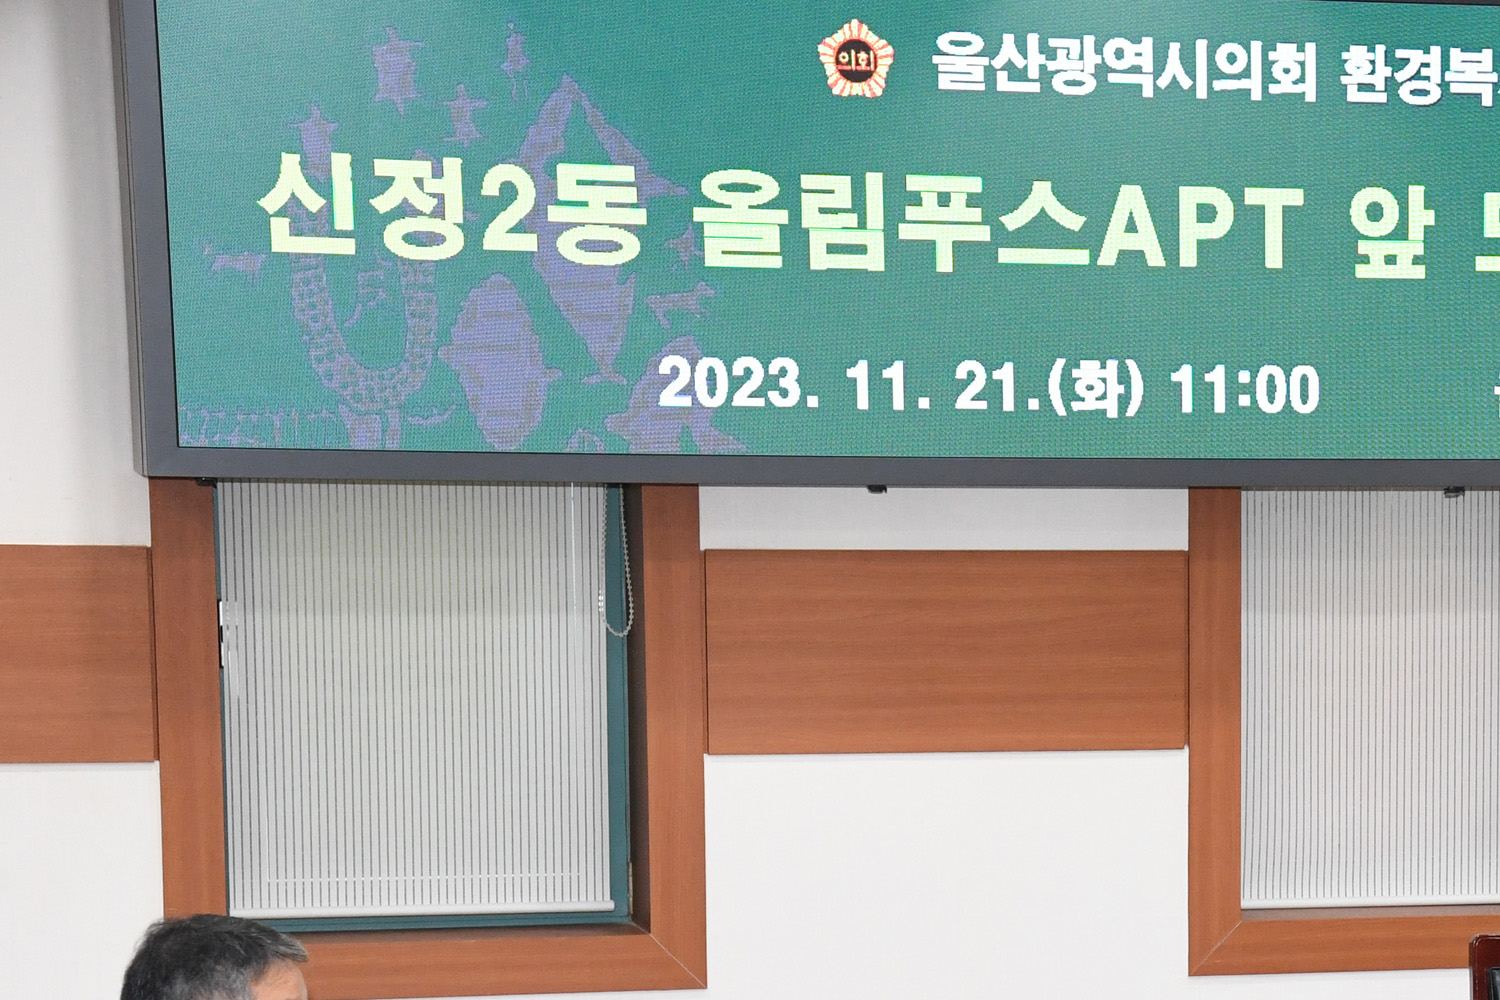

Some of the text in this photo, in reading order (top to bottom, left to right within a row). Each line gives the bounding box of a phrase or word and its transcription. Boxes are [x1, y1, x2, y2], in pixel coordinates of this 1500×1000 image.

[836, 49, 876, 71] 의회
[932, 31, 1317, 103] 울산광역시의회
[256, 151, 648, 266] 신정2동
[692, 169, 1305, 273] 올림푸스APT
[1349, 185, 1435, 279] 앞
[657, 354, 819, 409] 2023.
[846, 359, 930, 411] 11.
[1170, 364, 1320, 415] 11:00
